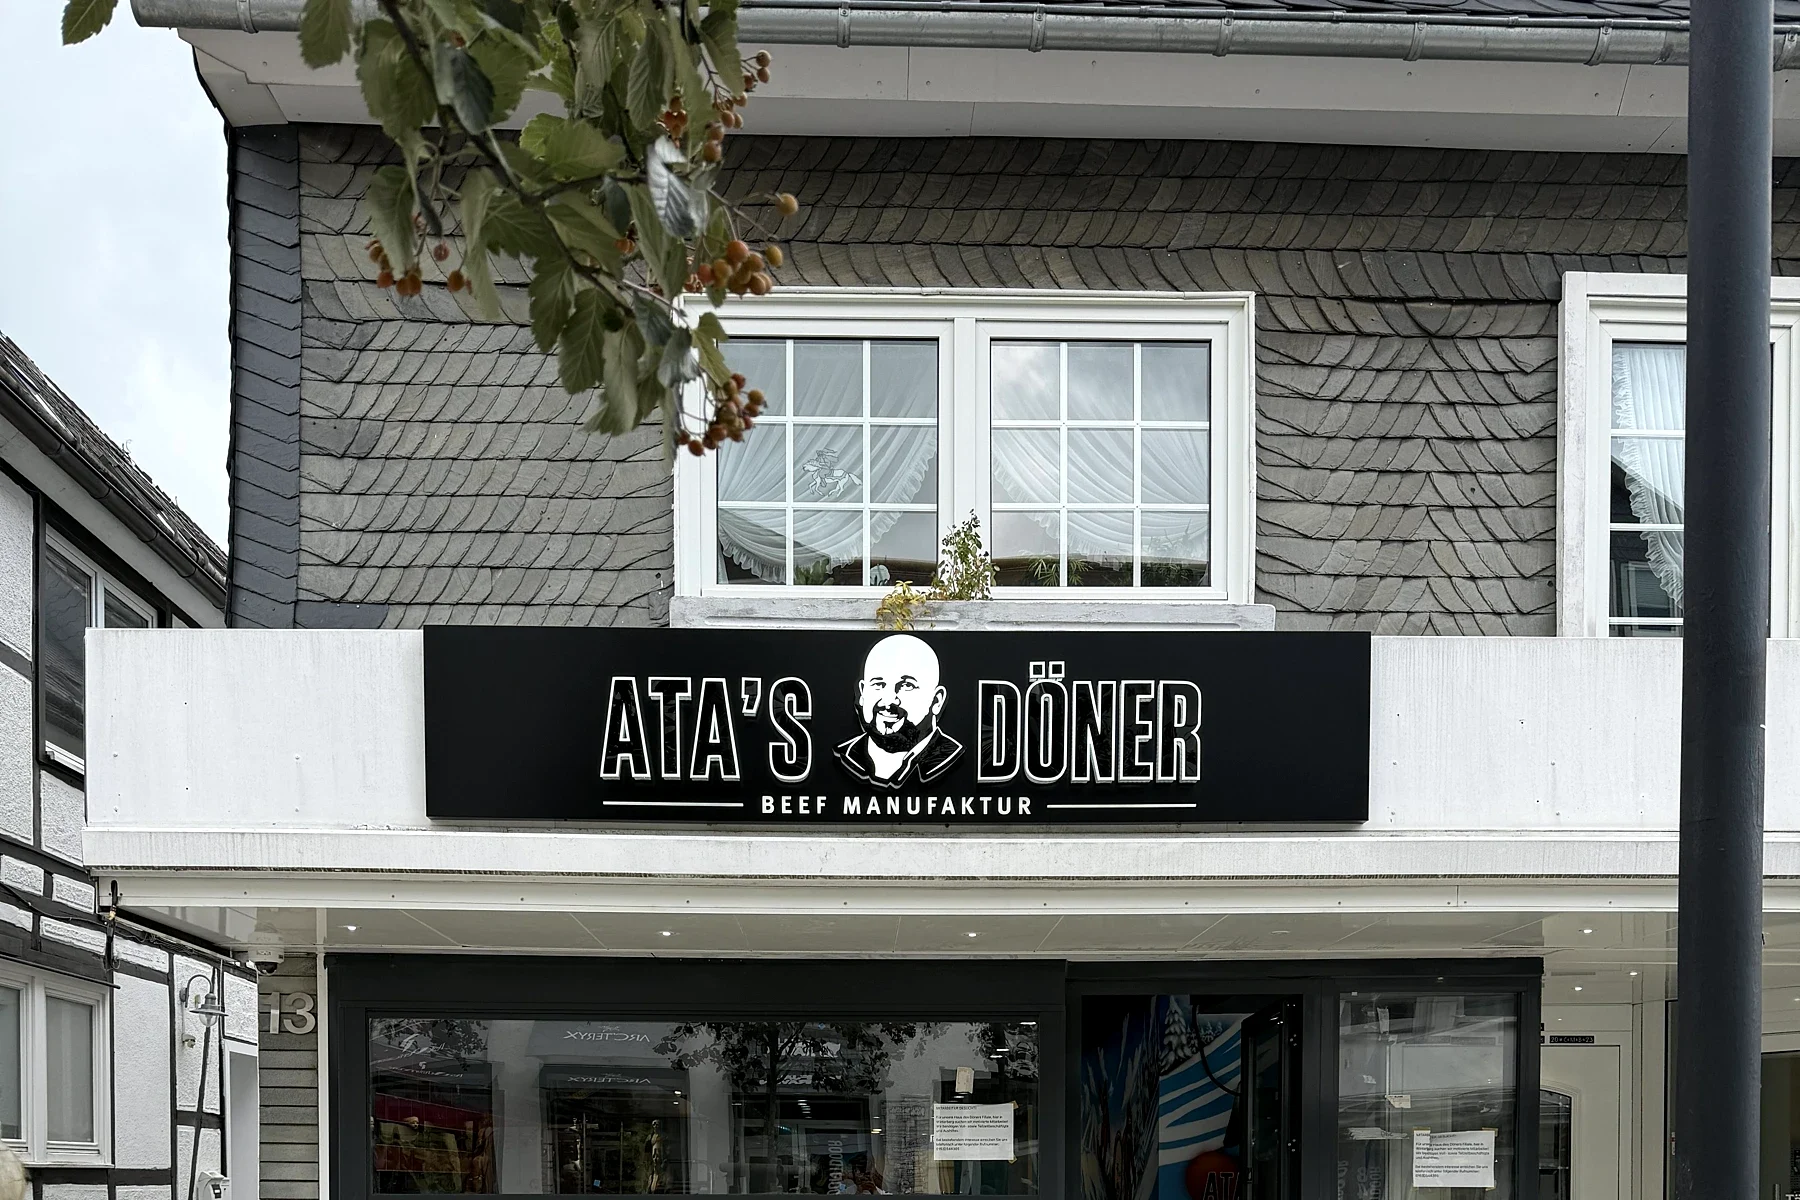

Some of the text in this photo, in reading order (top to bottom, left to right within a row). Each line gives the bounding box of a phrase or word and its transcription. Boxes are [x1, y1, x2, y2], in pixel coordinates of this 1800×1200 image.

[600, 660, 1202, 784] ATA'S DÖNER
[761, 795, 1032, 815] BEEF MANUFAKTUR
[264, 991, 316, 1035] 13
